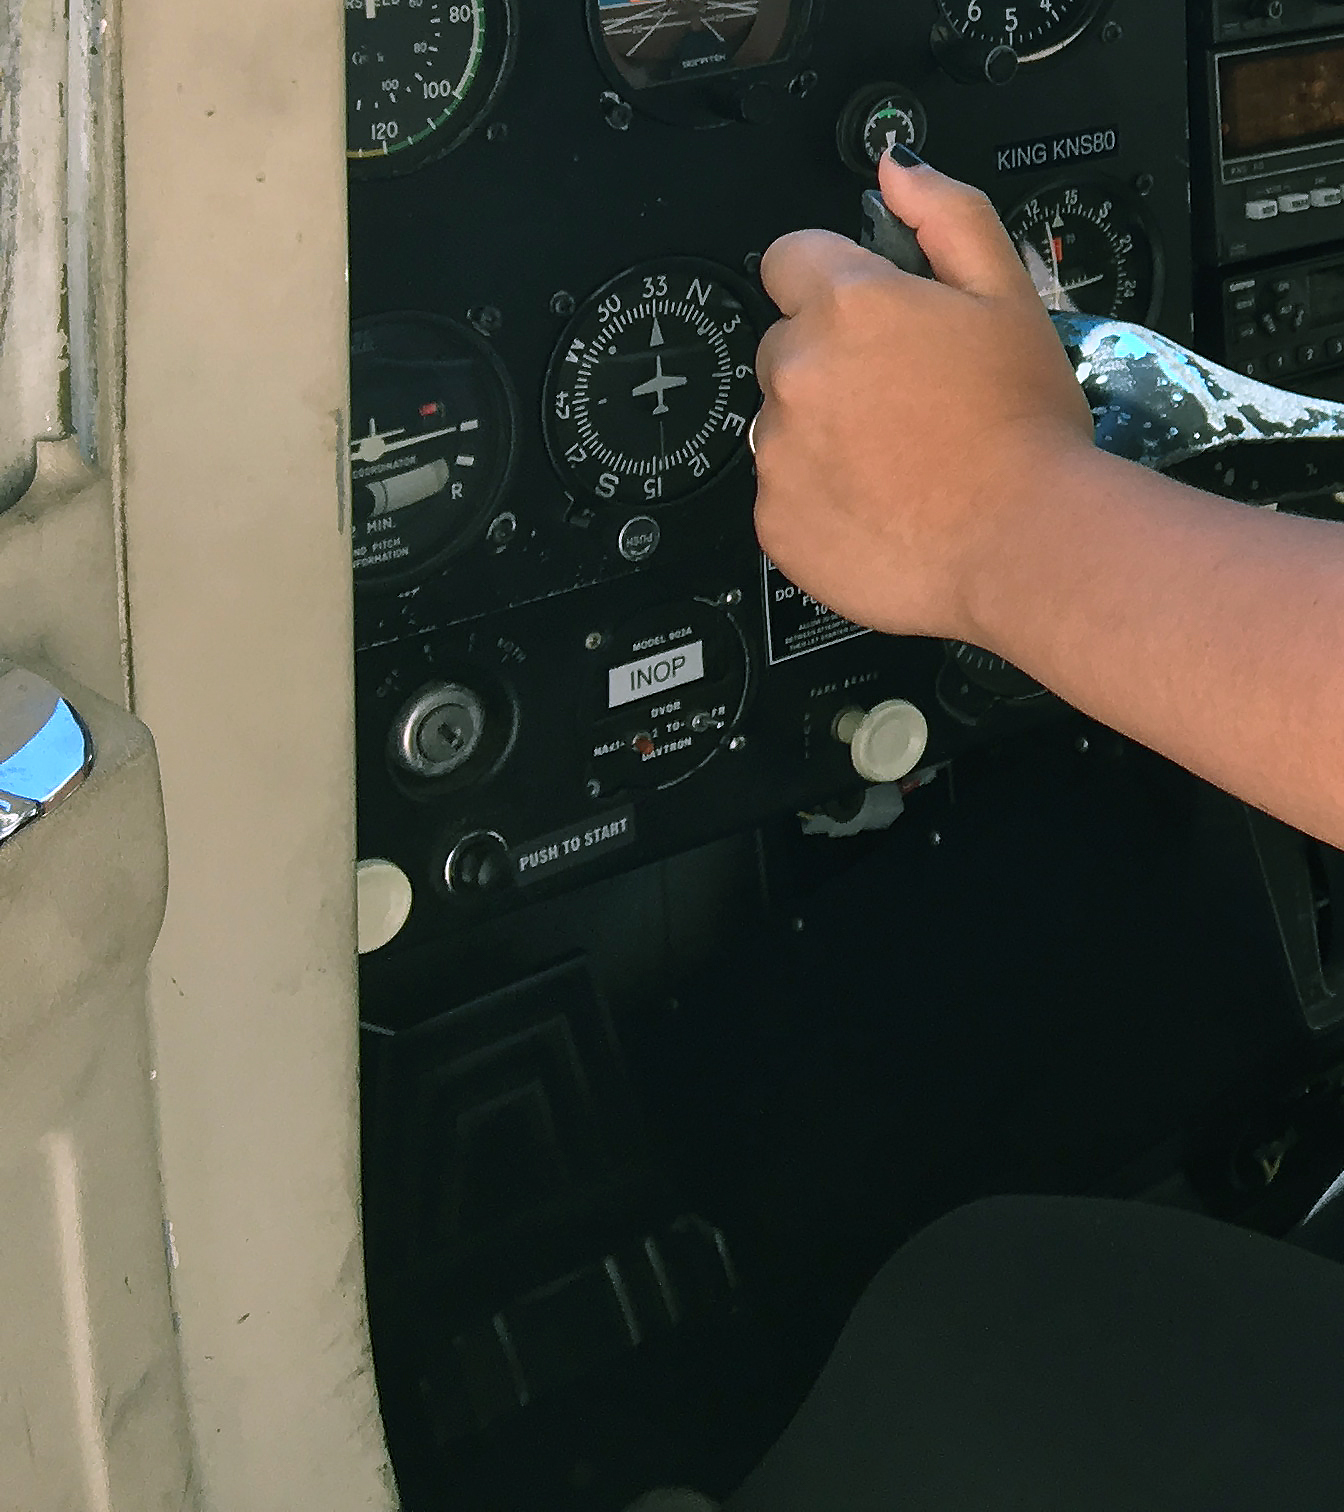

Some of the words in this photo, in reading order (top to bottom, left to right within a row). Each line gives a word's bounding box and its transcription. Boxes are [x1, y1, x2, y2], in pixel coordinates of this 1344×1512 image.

[449, 4, 473, 25] 80
[1005, 6, 1019, 32] 5
[424, 78, 452, 100] 100
[371, 121, 399, 142] 120
[997, 146, 1048, 171] KING
[1052, 128, 1117, 161] KNS80
[1064, 188, 1080, 206] 15
[1024, 198, 1041, 224] 12
[641, 274, 669, 300] 33
[685, 277, 713, 307] N
[597, 293, 622, 324] 30
[722, 313, 742, 335] 3
[564, 336, 586, 365] W
[735, 363, 754, 380] 6
[555, 390, 571, 421] 24
[721, 412, 747, 438] E
[687, 451, 712, 478] 12
[451, 481, 464, 501] R
[595, 472, 620, 499] S
[642, 475, 663, 501] 15
[775, 585, 796, 603] DO
[629, 654, 687, 692] INOP
[519, 845, 559, 873] PUSH
[561, 835, 582, 858] TO
[584, 818, 630, 851] START
